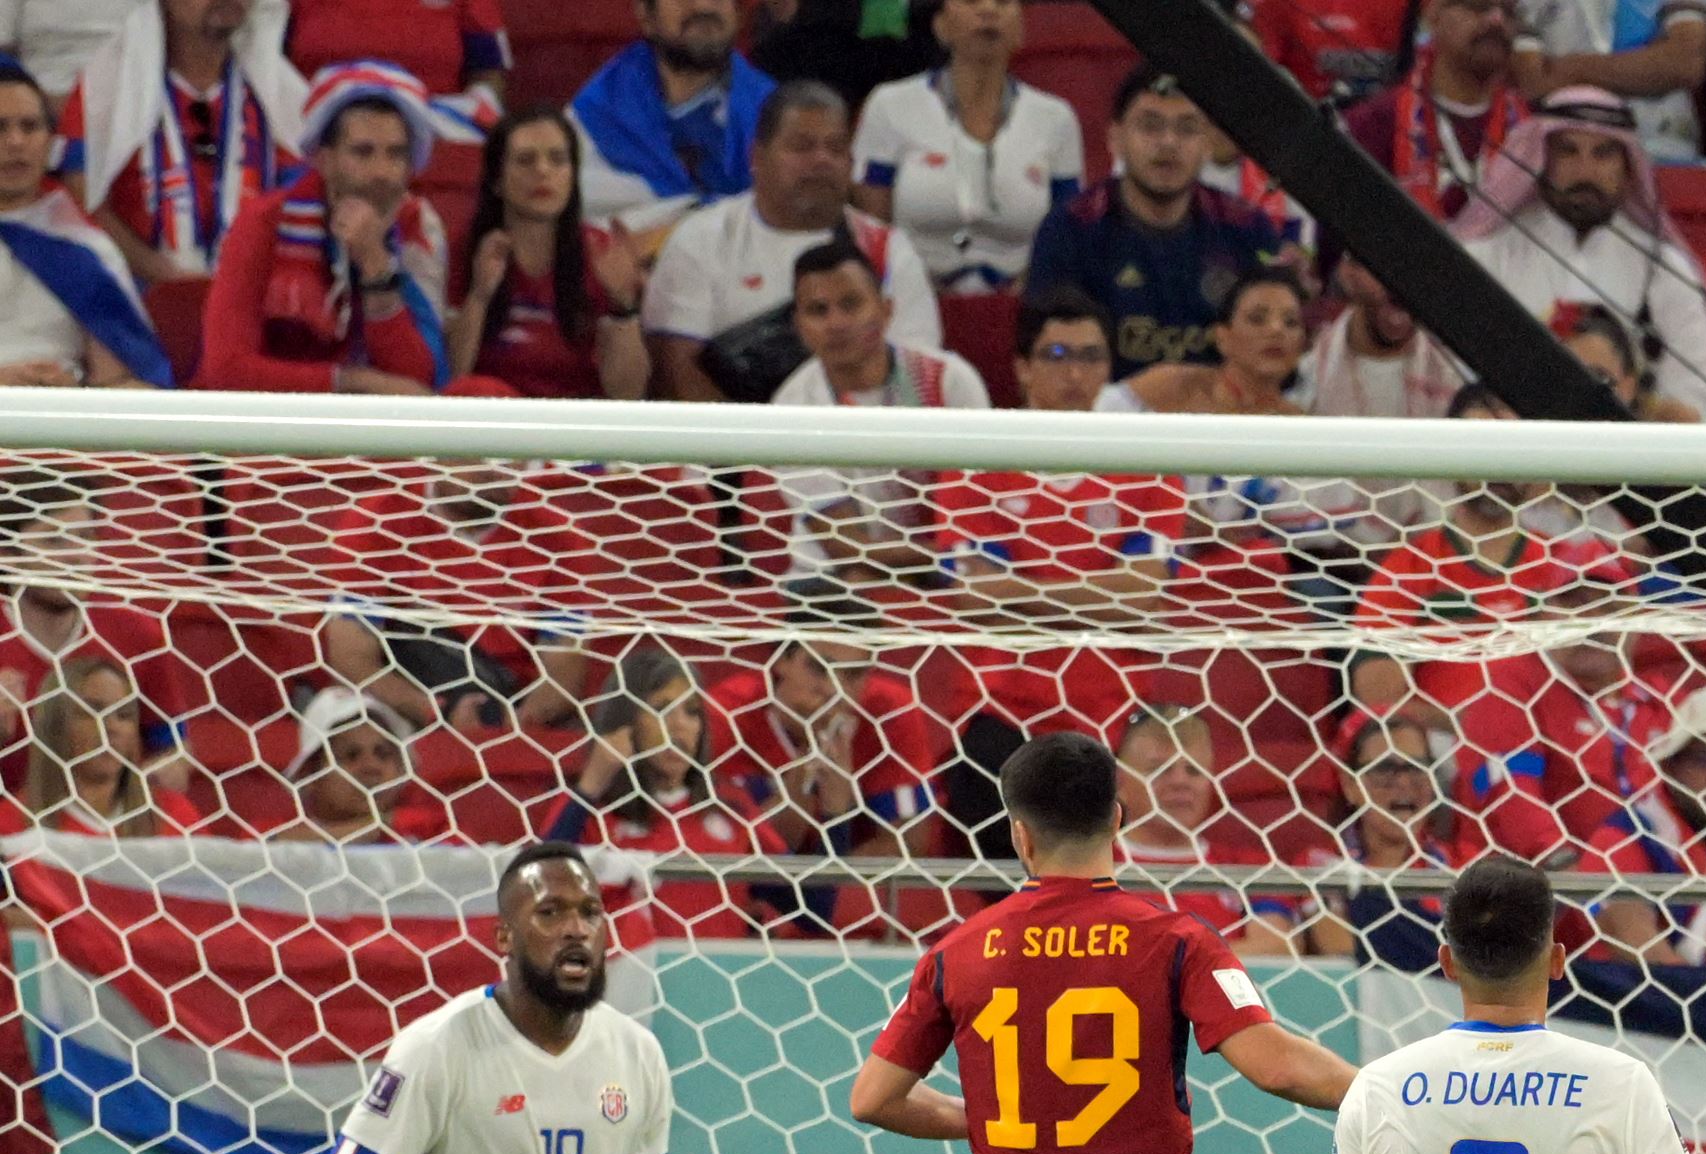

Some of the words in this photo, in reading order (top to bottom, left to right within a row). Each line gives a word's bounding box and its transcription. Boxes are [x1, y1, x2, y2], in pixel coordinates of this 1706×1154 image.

[983, 928, 1006, 959] C.
[1022, 924, 1130, 958] SOLER
[971, 986, 1141, 1149] 19
[1401, 1071, 1432, 1107] O.
[1443, 1071, 1589, 1108] DUARTE
